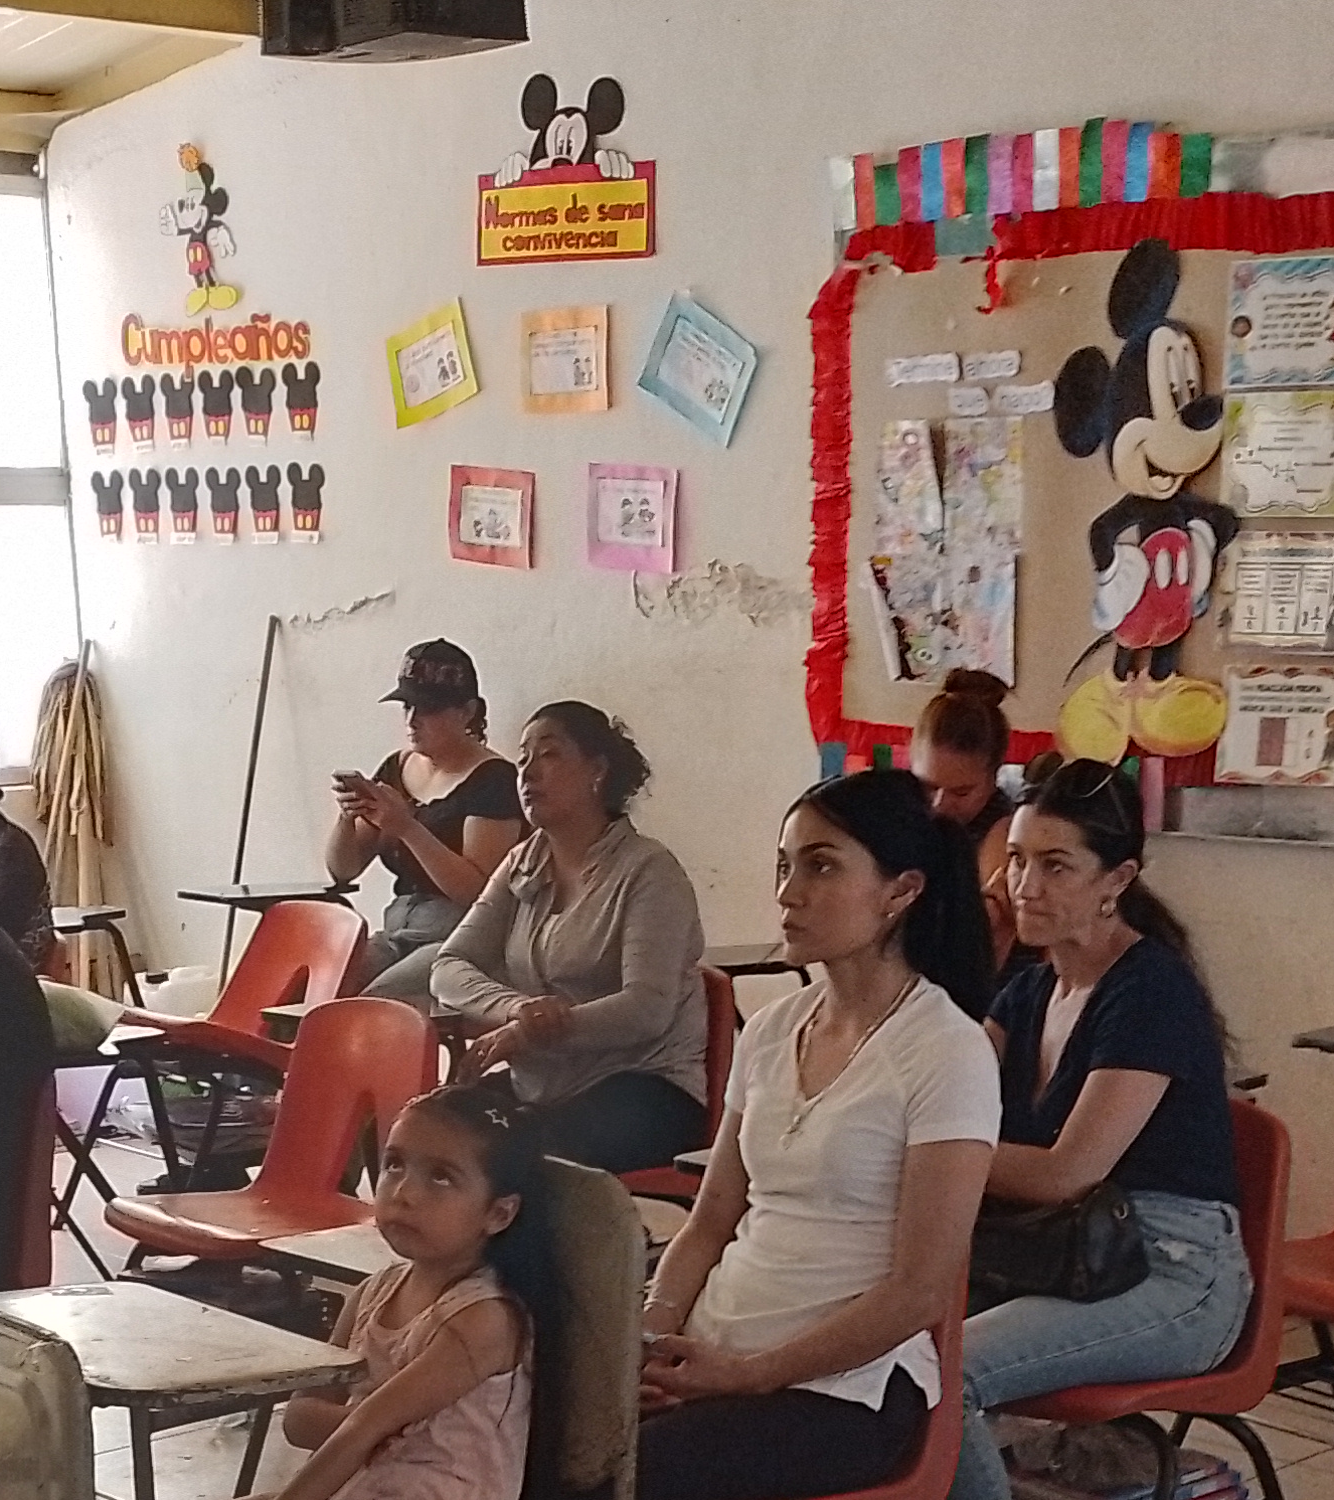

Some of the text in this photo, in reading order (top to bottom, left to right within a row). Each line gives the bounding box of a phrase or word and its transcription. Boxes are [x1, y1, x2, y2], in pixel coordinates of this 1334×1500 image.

[484, 193, 645, 229] Normas de sana
[502, 230, 619, 252] convivencia
[121, 313, 311, 379] Cumpleaños
